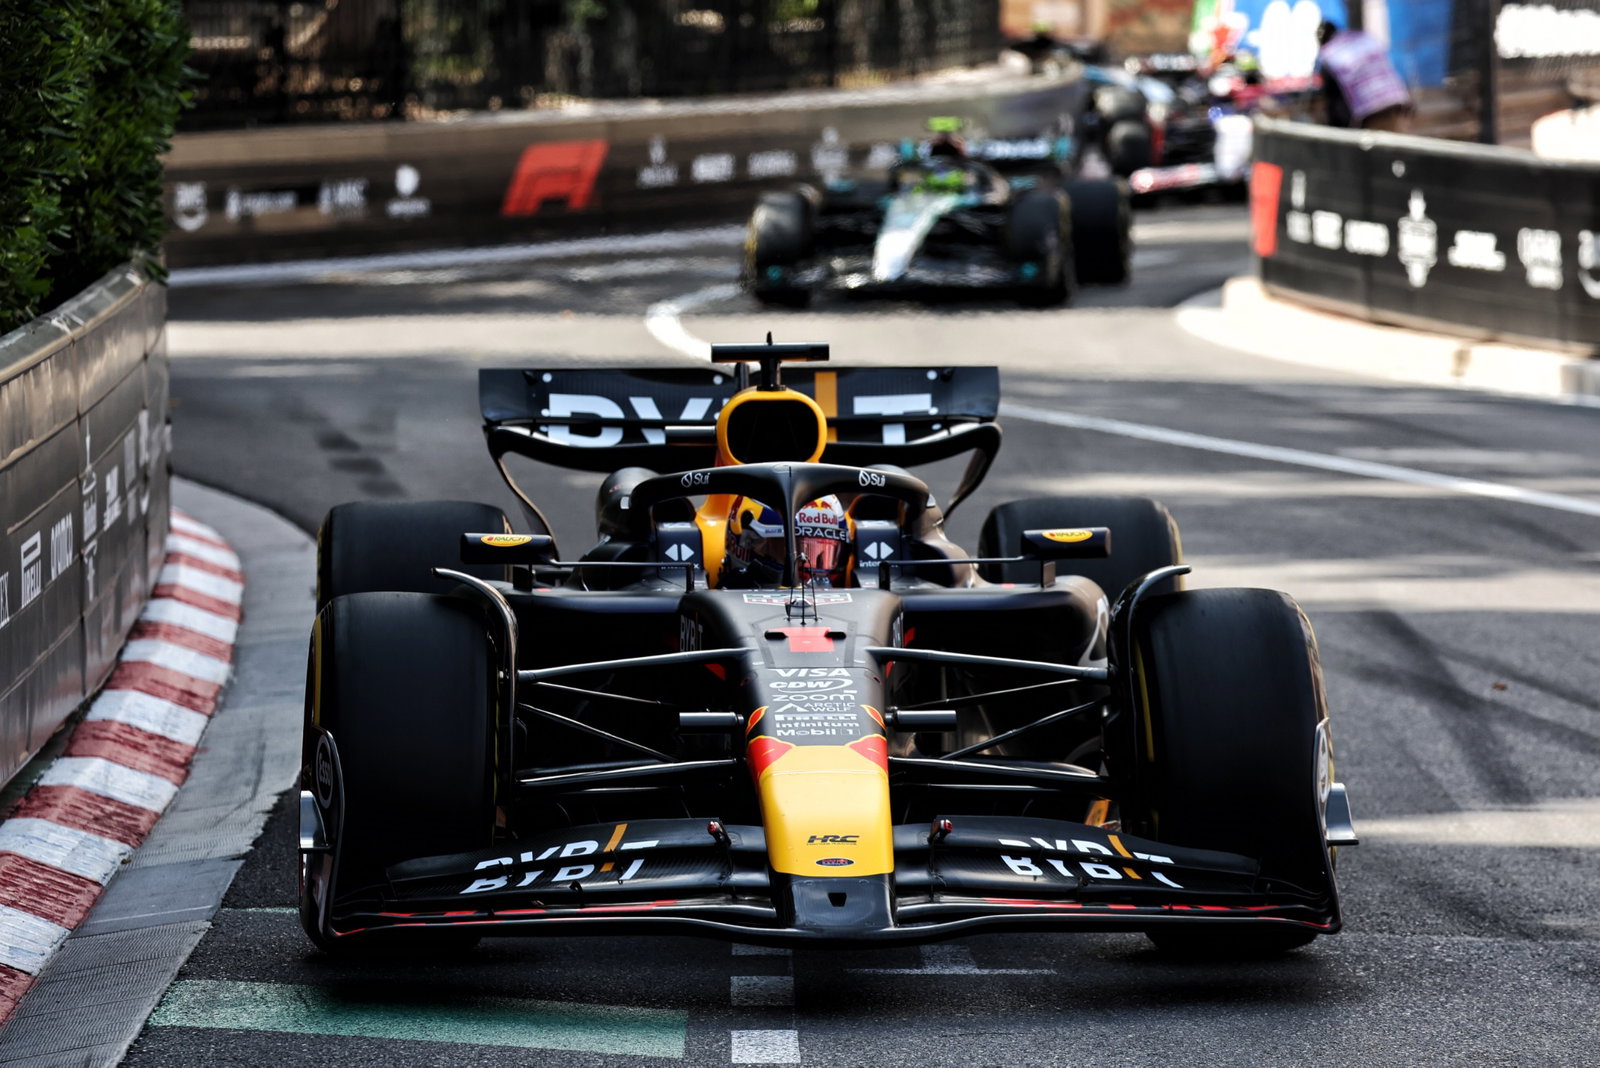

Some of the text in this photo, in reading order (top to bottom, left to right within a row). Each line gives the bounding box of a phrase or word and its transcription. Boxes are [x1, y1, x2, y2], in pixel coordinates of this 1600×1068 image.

[547, 372, 932, 447] BYIT
[693, 472, 711, 485] Sui
[871, 474, 886, 486] Sui
[799, 512, 839, 525] Red Bull
[795, 526, 847, 541] ORACLE
[768, 668, 851, 677] VISA
[769, 681, 833, 689] CDW
[772, 694, 856, 702] zoom
[776, 728, 837, 737] Mobil
[807, 835, 860, 844] HRC
